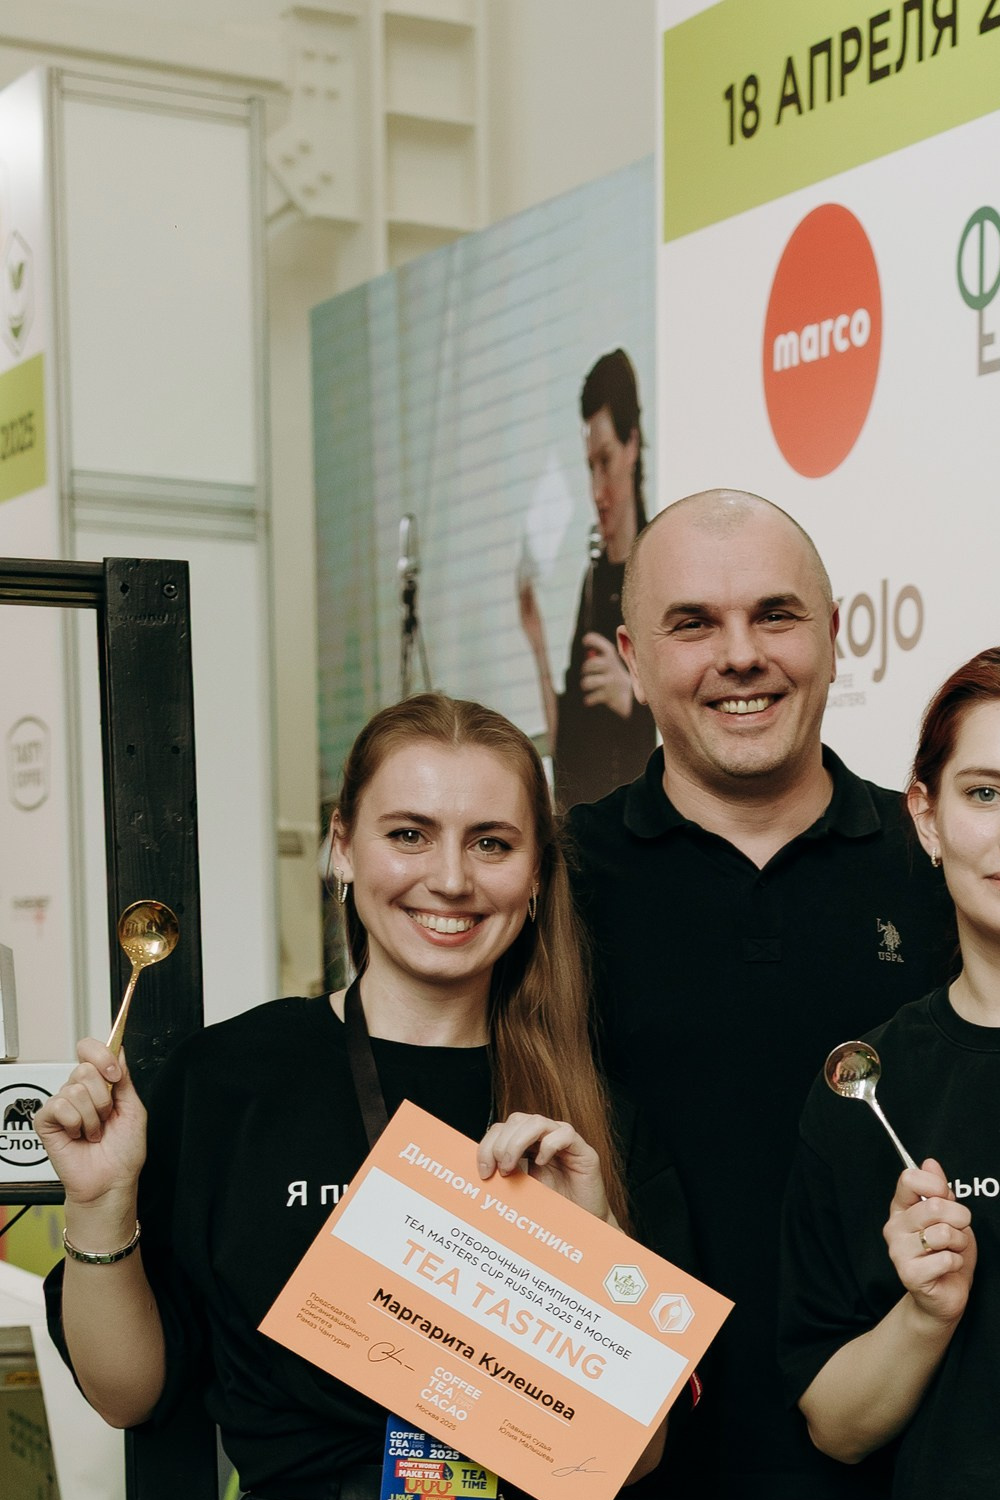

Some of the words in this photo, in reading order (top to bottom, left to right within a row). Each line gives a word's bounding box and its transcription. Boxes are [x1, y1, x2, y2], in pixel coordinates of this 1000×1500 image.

[724, 74, 760, 146] 18
[775, 0, 958, 126] АПРЕЛЯ
[773, 307, 871, 373] marco
[286, 1180, 308, 1208] Я
[399, 1143, 479, 1198] Диплом
[481, 1194, 582, 1262] участника
[947, 1177, 1000, 1198] ью
[404, 1214, 424, 1233] TEA
[427, 1230, 478, 1265] MASTERS
[480, 1262, 503, 1278] CUP
[504, 1277, 542, 1306] RUSSIA
[545, 1302, 573, 1323] 2025
[583, 1326, 631, 1359] МОСКВЕ
[450, 1227, 529, 1279] ОТБОРОЧНЫЙ
[532, 1276, 600, 1322] ЧЕМПИОНАТ
[300, 1307, 332, 1328] комитета
[305, 1299, 369, 1341] Организационного
[309, 1292, 356, 1324] Председатель
[403, 1239, 459, 1294] TEA
[473, 1282, 605, 1378] TASTING
[296, 1312, 313, 1327] Рамаз
[312, 1323, 350, 1348] Чантурия
[373, 1288, 474, 1358] Маргарита
[479, 1353, 574, 1419] Кулешова
[429, 1375, 452, 1398] TEA
[434, 1366, 481, 1399] COFFEE
[415, 1402, 439, 1420] Москва
[439, 1417, 456, 1430] 2025
[420, 1388, 467, 1420] CACAO
[389, 1439, 409, 1448] TEA
[390, 1431, 425, 1441] COFFEE
[498, 1425, 517, 1440] Юлия
[518, 1438, 553, 1463] Малышева
[502, 1418, 531, 1439] Главный
[532, 1438, 551, 1451] судья
[388, 1448, 424, 1458] CACAO
[429, 1449, 460, 1460] 2025
[398, 1470, 423, 1479] MAKE
[424, 1471, 441, 1480] TEA
[461, 1469, 487, 1481] TEA
[462, 1480, 487, 1490] TIME
